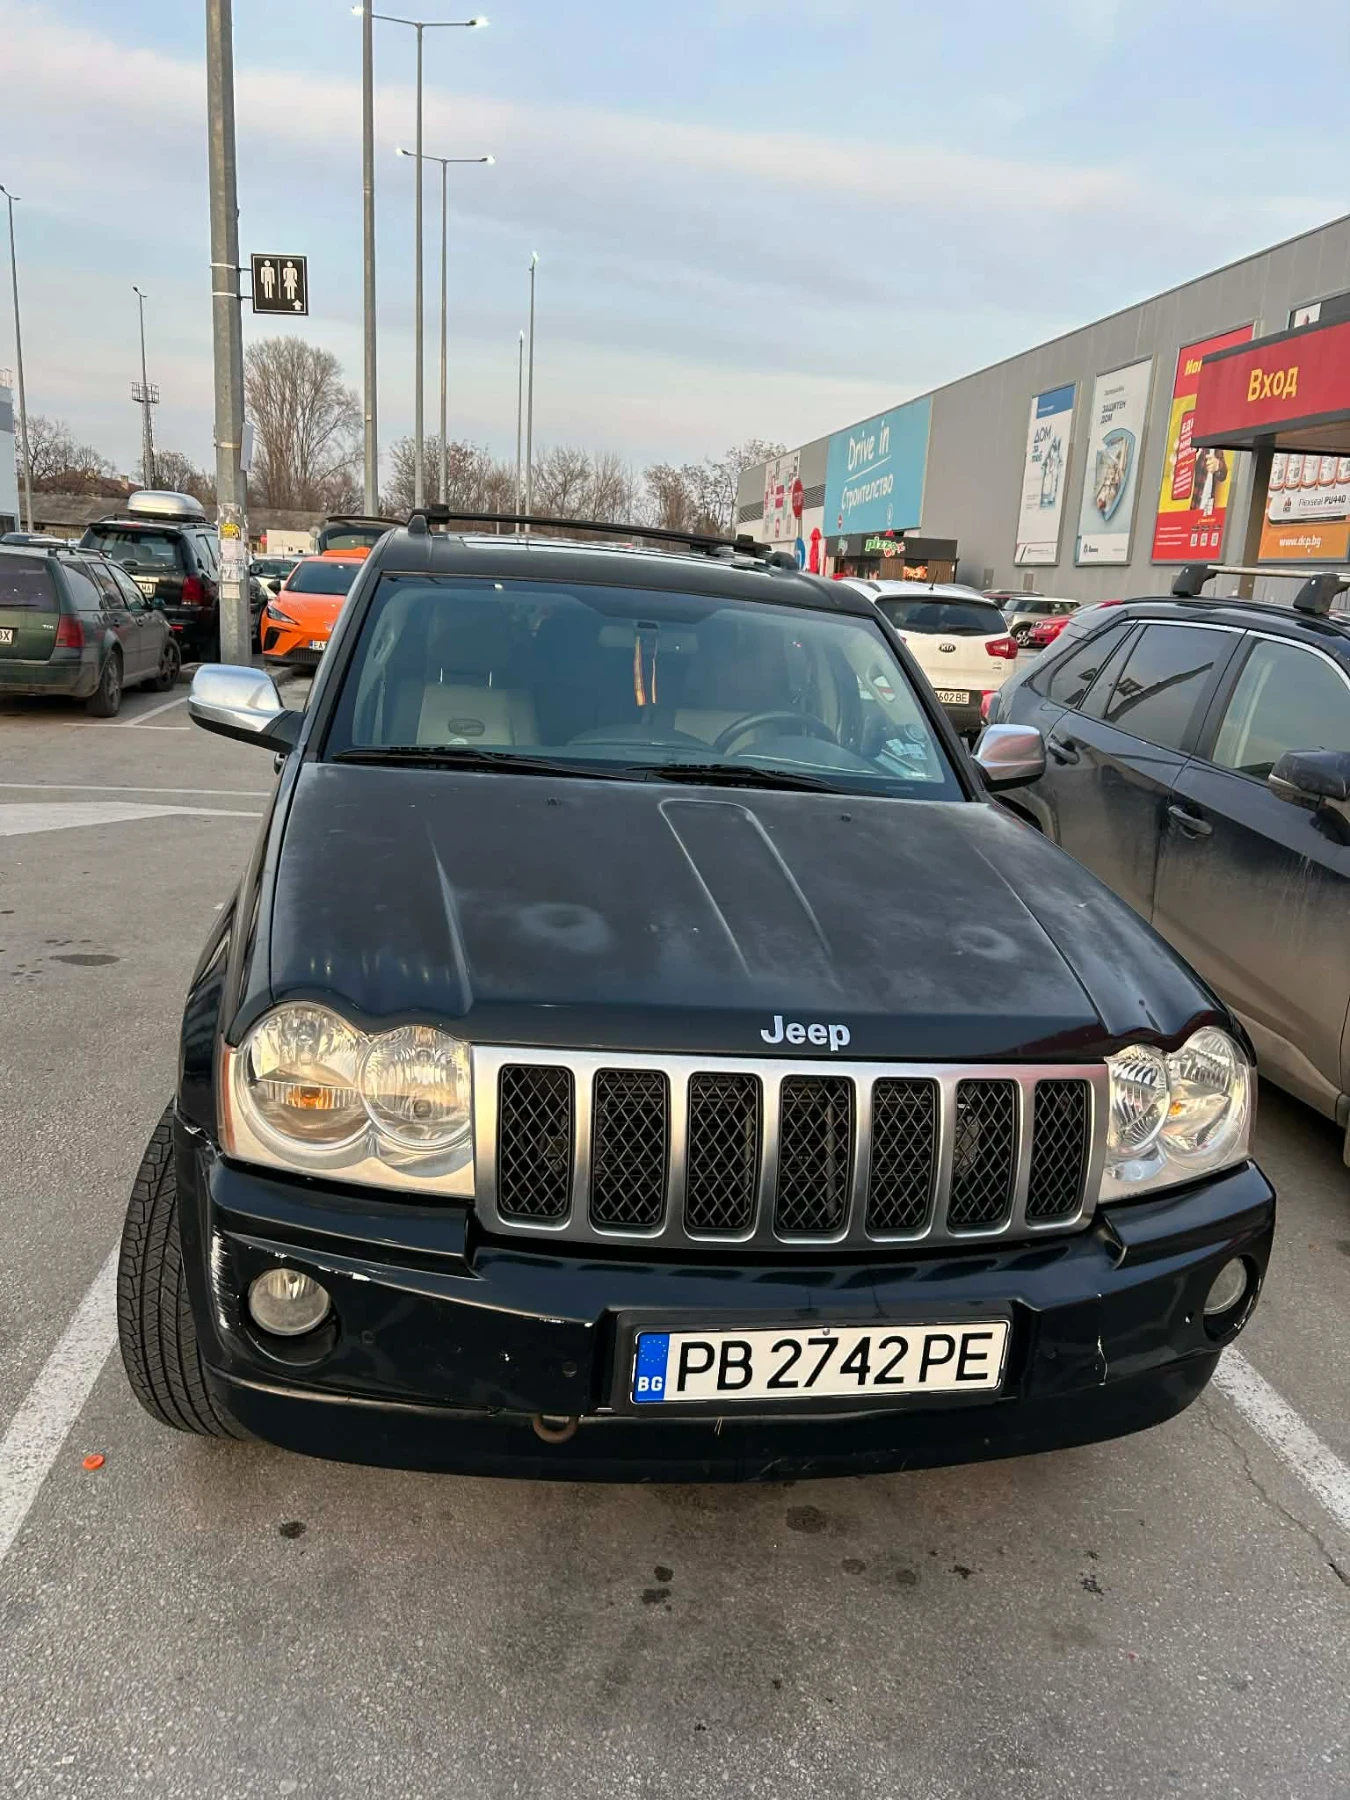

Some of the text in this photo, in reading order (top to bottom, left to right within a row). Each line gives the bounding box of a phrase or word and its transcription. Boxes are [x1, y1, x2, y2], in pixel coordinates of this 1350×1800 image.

[1248, 366, 1299, 401] Вход
[848, 419, 890, 472] Drive in
[1279, 535, 1322, 548] www.dcp.bg
[761, 1015, 851, 1051] Jeep
[677, 1332, 994, 1392] PB 2742 PE
[638, 1375, 663, 1392] BG
